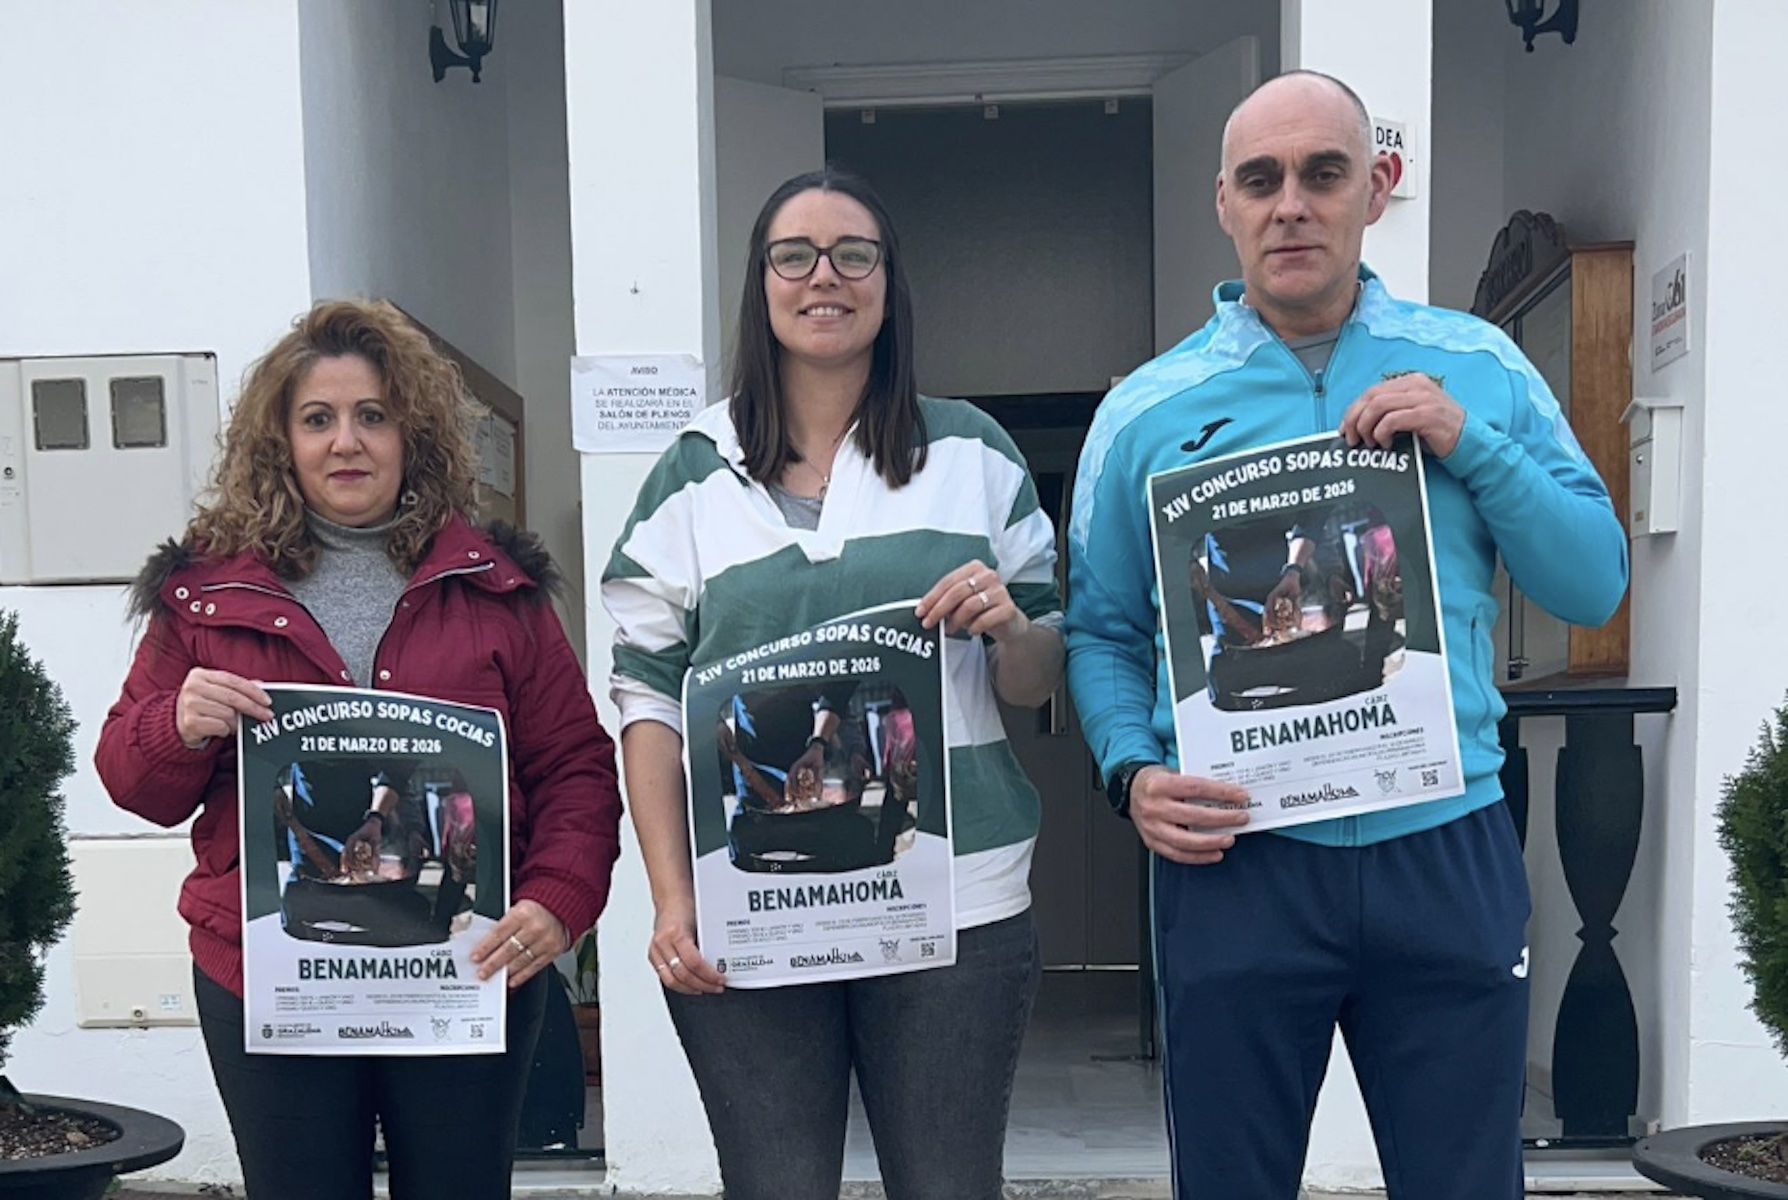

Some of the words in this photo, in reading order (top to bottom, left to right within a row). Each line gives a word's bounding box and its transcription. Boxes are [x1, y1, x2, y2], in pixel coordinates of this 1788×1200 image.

[1376, 126, 1404, 149] DEA
[630, 366, 658, 375] AVISO
[592, 388, 605, 397] LA
[606, 386, 656, 397] ATENCIÓN
[659, 386, 697, 397] MÉDICA
[595, 399, 608, 408] SE
[666, 399, 680, 408] EN
[682, 399, 694, 408] EL
[599, 408, 633, 419] SALÓN
[635, 410, 649, 419] DE
[651, 410, 691, 419] PLENOS
[597, 421, 617, 431] DEL
[1162, 493, 1192, 523] XIV
[1190, 456, 1282, 504] CONCURSO
[1286, 449, 1343, 472] SOPAS
[1346, 449, 1410, 472] COCIAS
[1212, 503, 1228, 520] 21
[1228, 499, 1248, 517] DE
[1249, 491, 1299, 513] MARZO
[1301, 487, 1320, 504] DE
[1324, 479, 1355, 499] 2026
[696, 664, 723, 686] XIV
[725, 632, 812, 671] CONCURSO
[815, 624, 871, 643] SOPAS
[873, 626, 936, 660] COCIAS
[741, 670, 757, 684] 21
[758, 666, 777, 682] DE
[778, 661, 827, 681] MARZO
[829, 659, 847, 676] DE
[850, 656, 881, 673] 2026
[250, 718, 280, 745] XIV
[281, 700, 374, 731] CONCURSO
[377, 701, 432, 726] SOPAS
[435, 714, 496, 748] COCIAS
[1230, 703, 1397, 754] BENAMAHOMA
[301, 737, 317, 751] 21
[317, 737, 336, 751] DE
[338, 737, 388, 753] MARZO
[390, 738, 409, 753] DE
[411, 739, 442, 753] 2026
[748, 878, 904, 913] BENAMAHOMA
[298, 957, 459, 981] BENAMAHOMA
